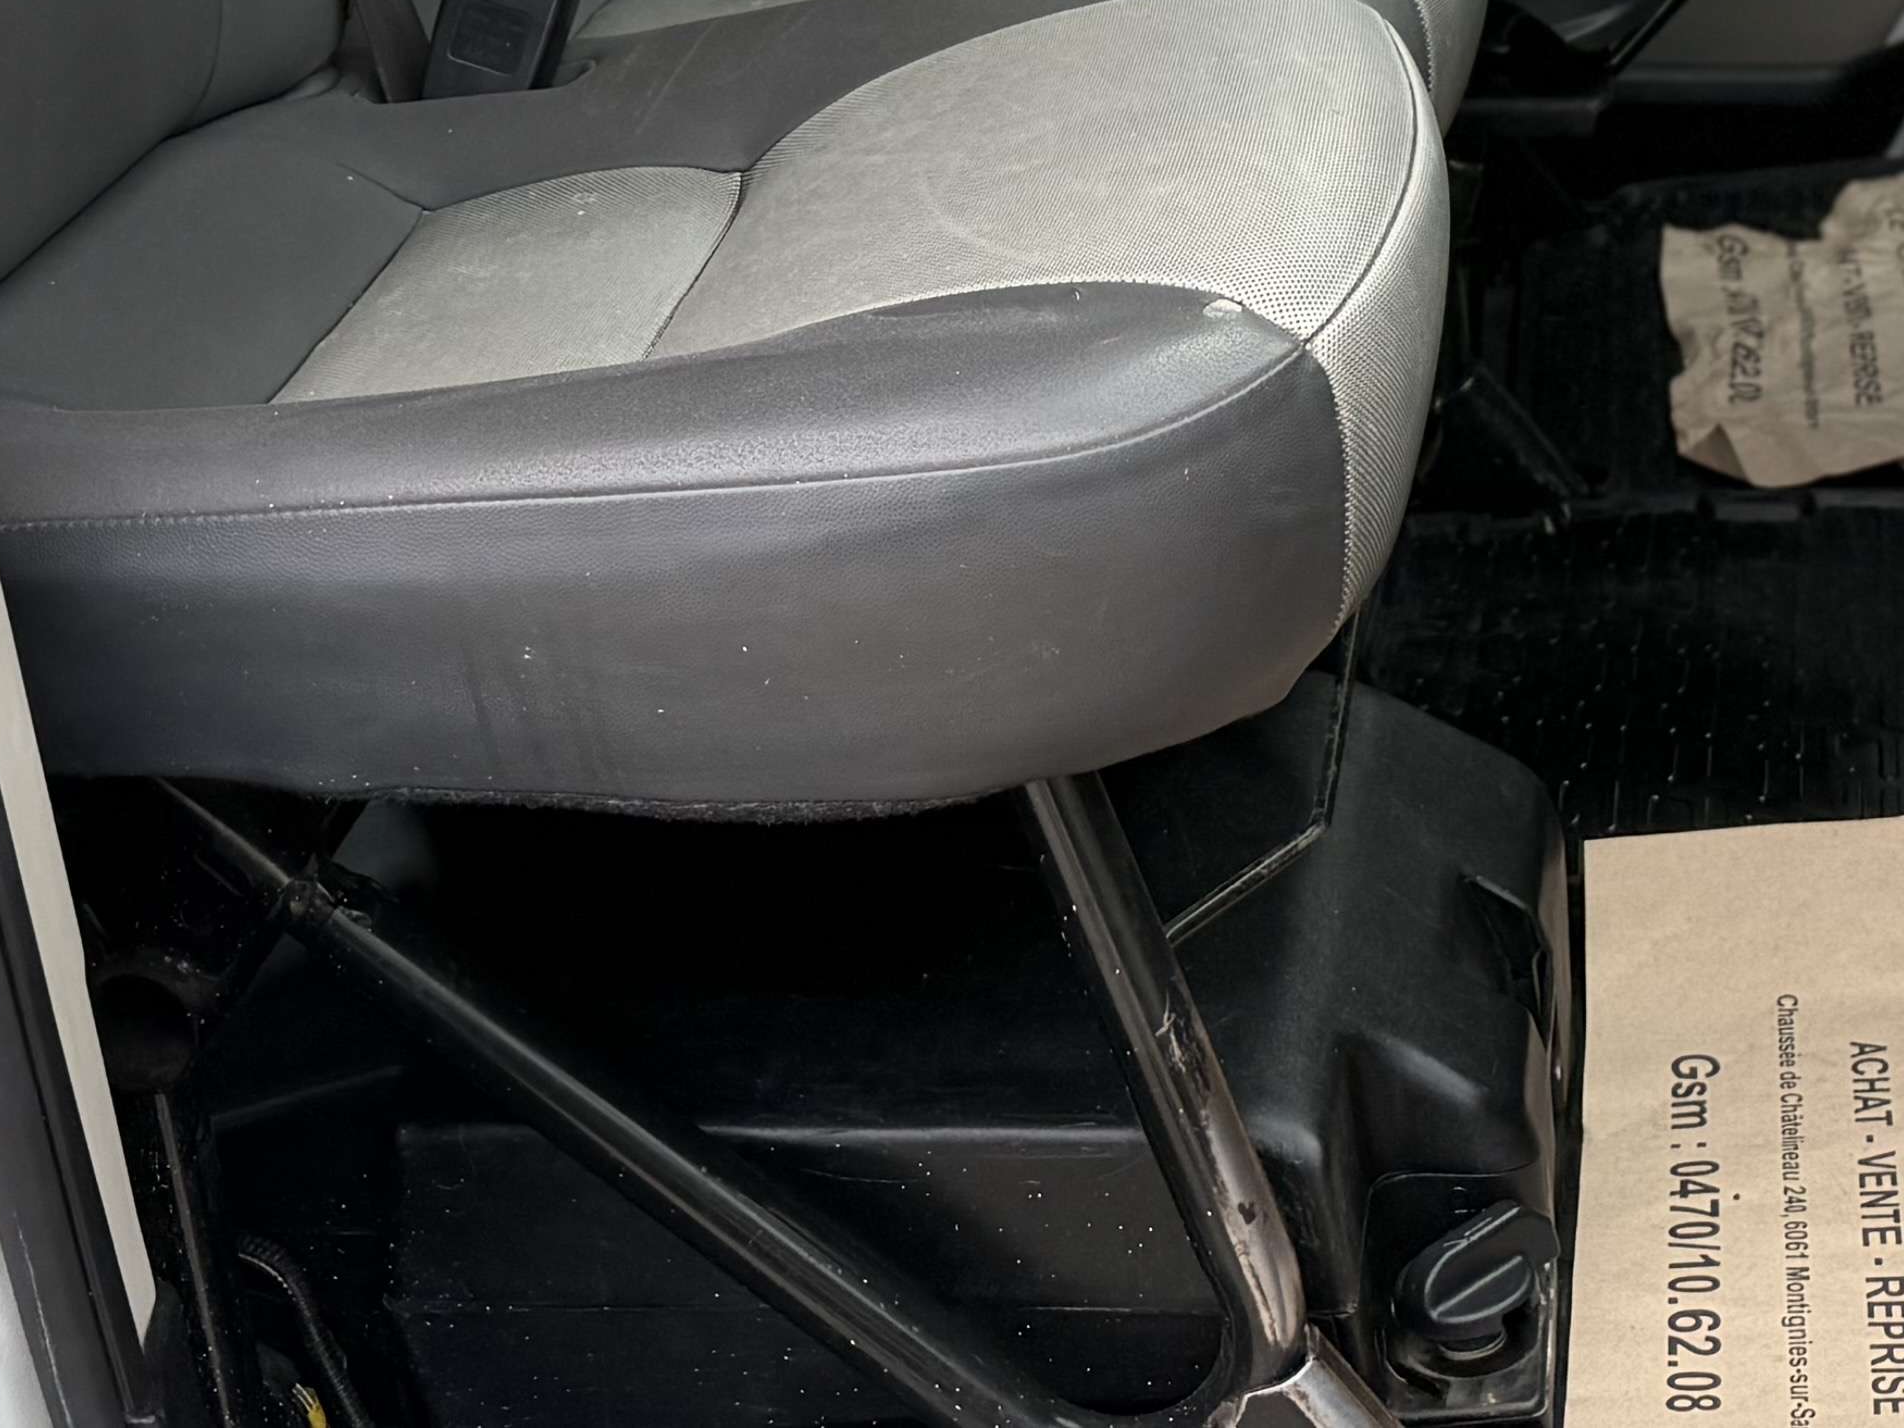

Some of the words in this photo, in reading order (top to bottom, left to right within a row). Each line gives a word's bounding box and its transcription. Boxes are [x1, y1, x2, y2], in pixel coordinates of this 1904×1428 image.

[1670, 1054, 1721, 1130] Gsm
[1779, 1070, 1802, 1090] de
[1849, 1041, 1894, 1127] ACHAT
[1780, 1092, 1805, 1181] Châtelineau
[1777, 1185, 1808, 1218] 240,
[1784, 1220, 1810, 1260] 6061
[1856, 1150, 1903, 1248] VENTE
[1664, 1159, 1722, 1413] 0470/10.62.08
[1780, 1266, 1817, 1428] Montignies-sur-Sa
